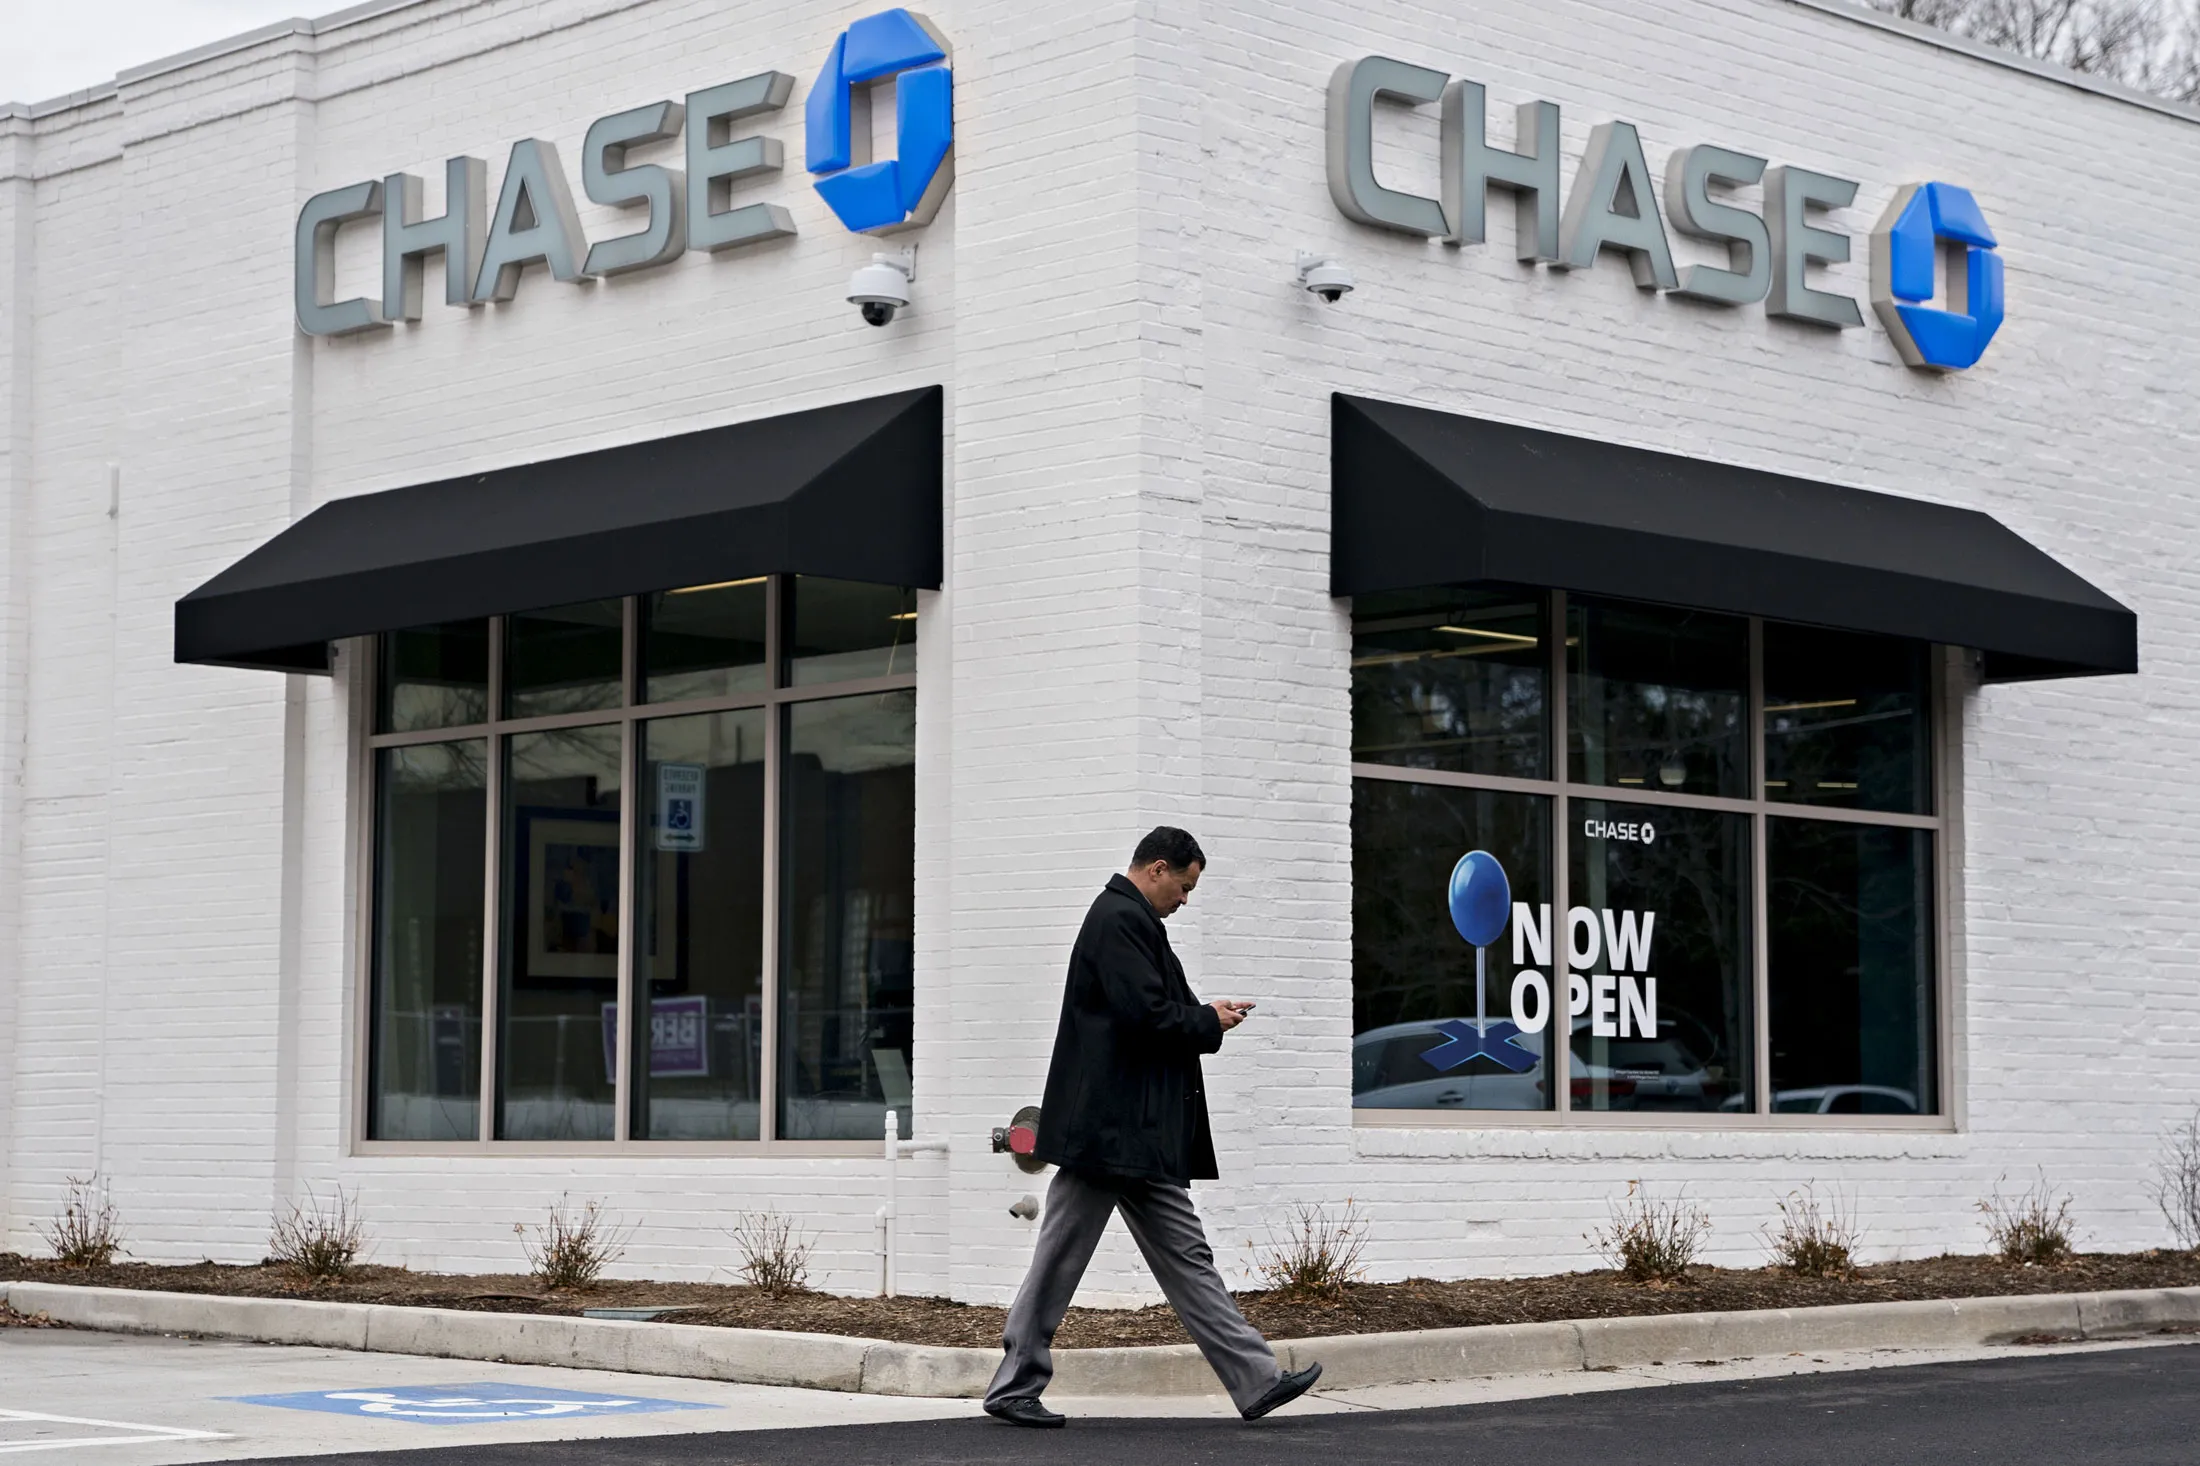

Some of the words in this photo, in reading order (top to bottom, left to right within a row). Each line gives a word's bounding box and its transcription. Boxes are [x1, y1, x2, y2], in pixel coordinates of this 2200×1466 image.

[295, 70, 797, 336] CHASE
[1325, 55, 1865, 330] CHASE
[1585, 820, 1639, 841] CHASE
[1512, 901, 1655, 972] NOW
[1510, 969, 1657, 1038] OPEN
